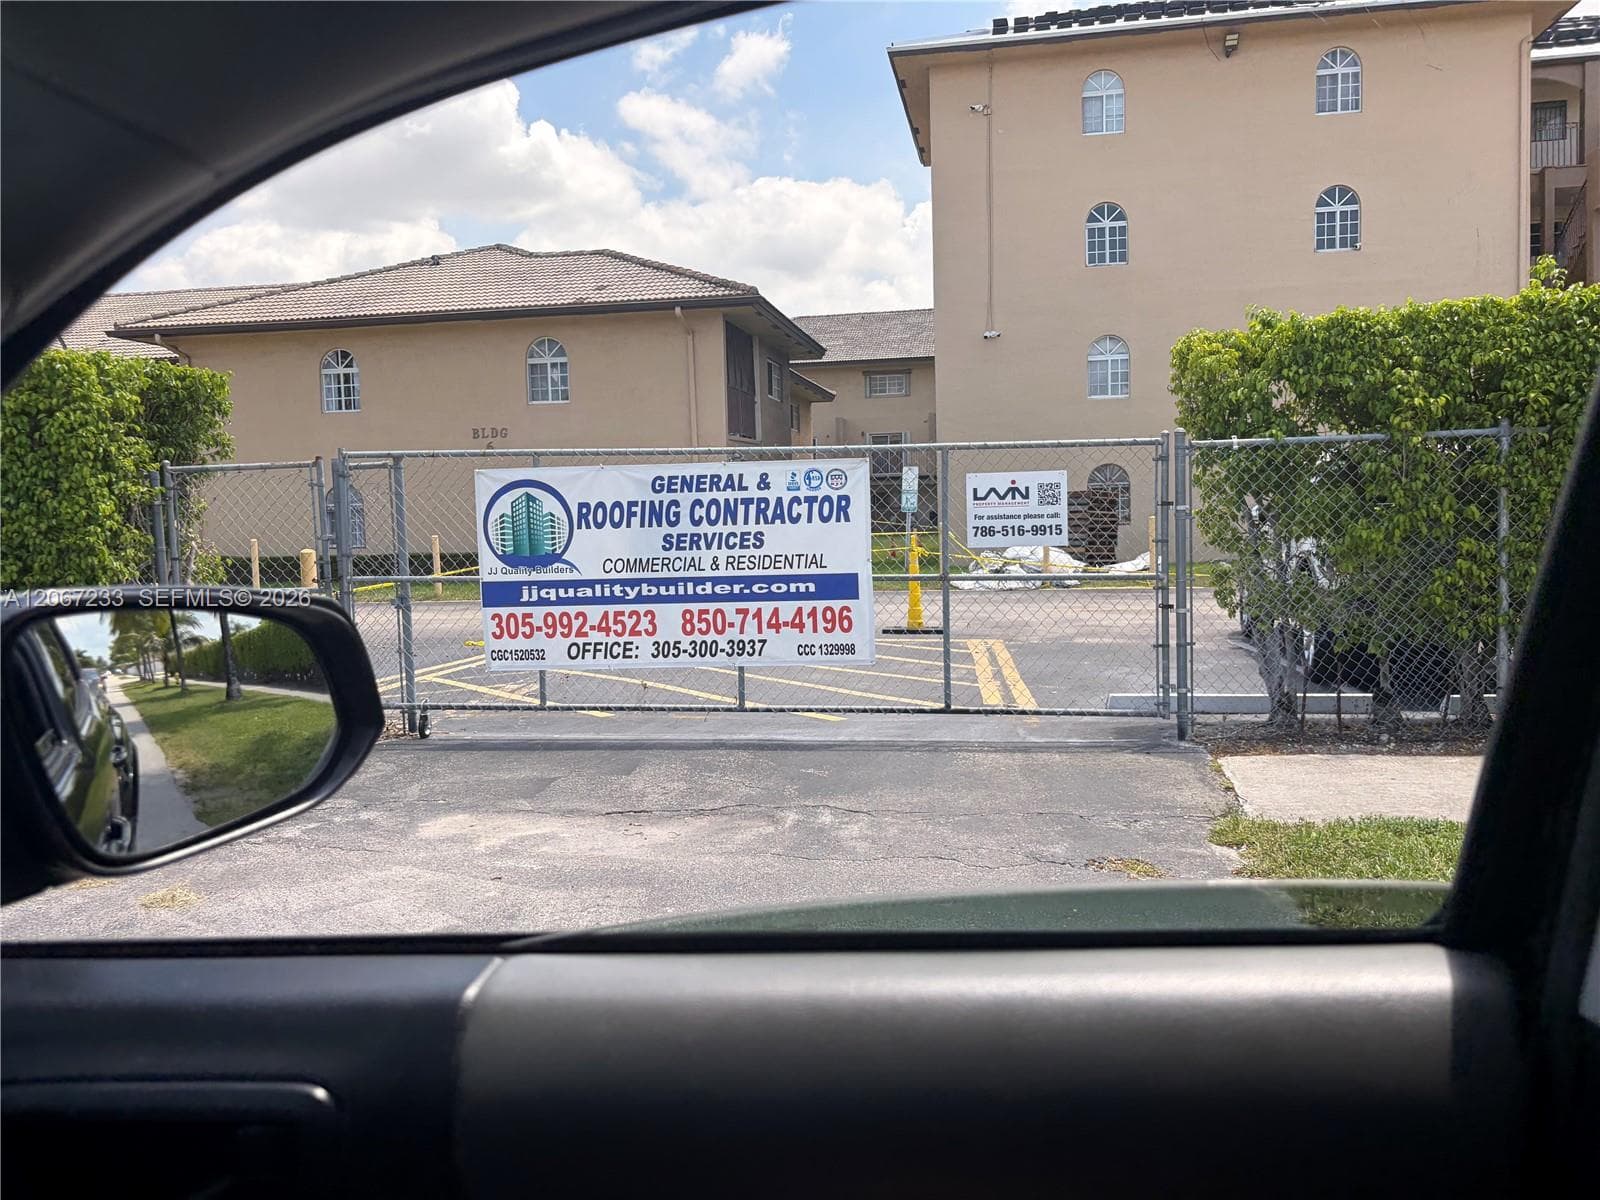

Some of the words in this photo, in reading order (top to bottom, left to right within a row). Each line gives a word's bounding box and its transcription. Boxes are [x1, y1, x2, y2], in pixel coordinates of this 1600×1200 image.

[472, 428, 508, 439] BLDG
[651, 473, 748, 494] GENERAL
[757, 472, 771, 491] &
[577, 499, 680, 529] ROOFING
[690, 495, 851, 527] CONTRACTOR
[986, 512, 1021, 521] assistance
[1023, 511, 1045, 520] please
[1046, 511, 1061, 519] call:
[661, 531, 765, 551] SERVICES
[972, 524, 1063, 537] 786-516-9915
[488, 567, 498, 575] JJ
[500, 566, 533, 576] Quality
[535, 565, 574, 575] Builders
[602, 556, 705, 574] COMMERCIAL
[710, 556, 720, 571] &
[725, 553, 828, 571] RESIDENTIAL
[520, 581, 816, 602] jjqualitybuilder.com
[490, 609, 657, 640] 305-992-4523
[681, 605, 853, 636] 850-714-4196
[490, 648, 546, 661] CGC1520532
[567, 641, 639, 660] OFFICE:
[651, 639, 767, 659] 305-300-3937
[797, 644, 816, 656] CCC
[818, 643, 856, 656] 1329998
